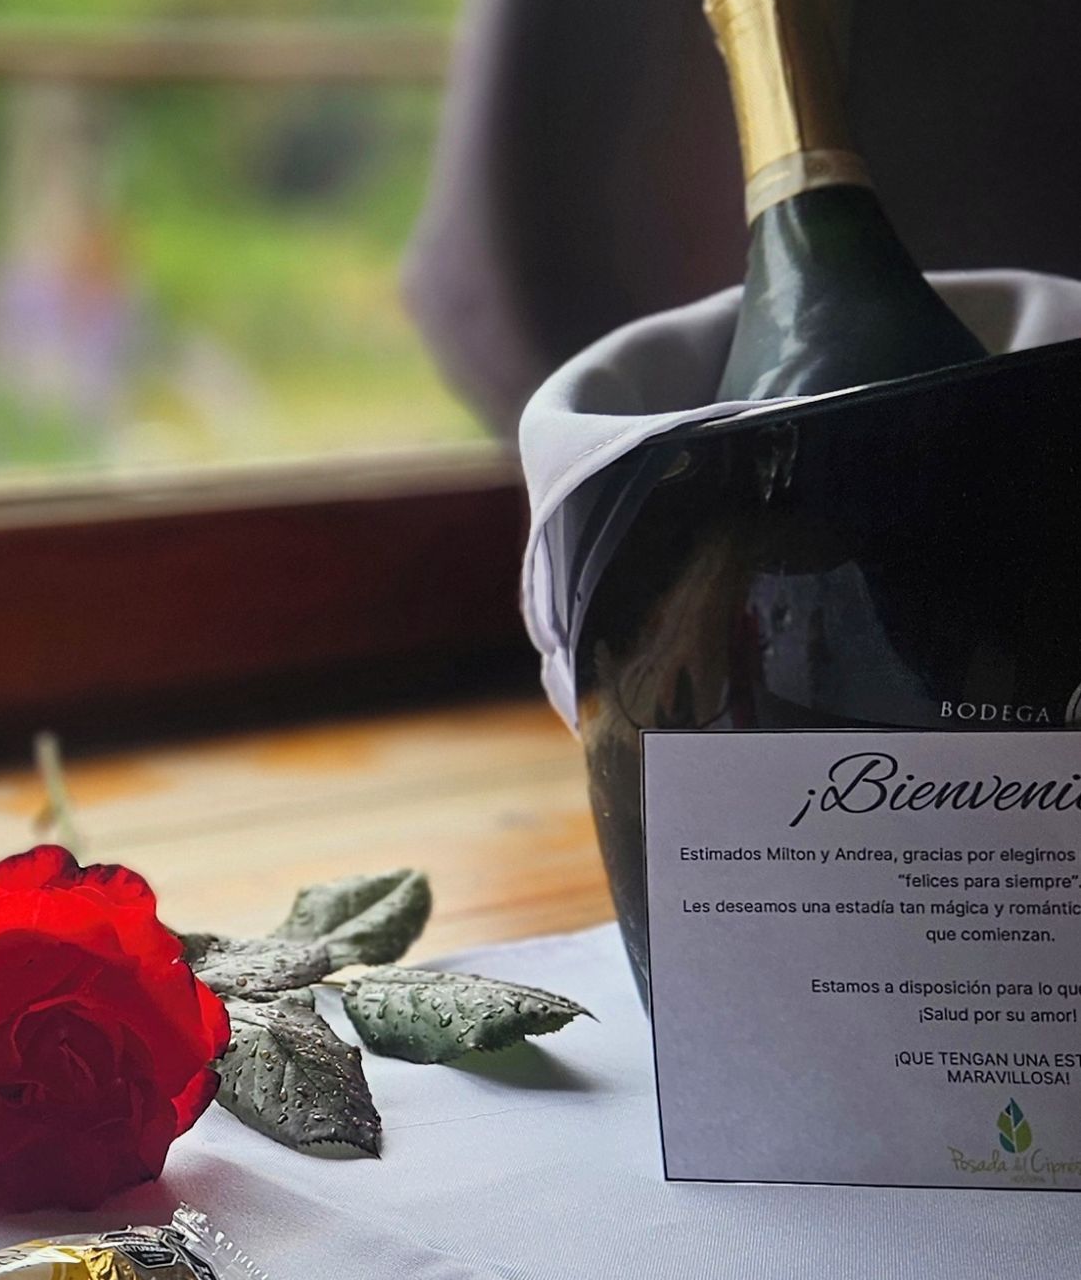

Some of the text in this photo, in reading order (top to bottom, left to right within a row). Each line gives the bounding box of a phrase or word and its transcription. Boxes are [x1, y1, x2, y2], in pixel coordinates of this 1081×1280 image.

[940, 700, 1049, 722] BODEGA
[789, 751, 1081, 827] ¡Bienveni
[681, 847, 1075, 865] Estimados Milton y Andrea, gracias por elegirnos
[898, 874, 959, 887] “felices
[964, 877, 1000, 890] para
[683, 900, 710, 912] Les
[716, 900, 797, 913] deseamos
[802, 903, 830, 913] una
[836, 900, 894, 914] estadía
[900, 902, 925, 914] tan
[931, 900, 988, 917] mágica
[994, 904, 1004, 918] y
[926, 928, 1055, 944] que comienzan.
[812, 979, 880, 993] Estamos
[885, 983, 893, 993] a
[899, 980, 991, 997] disposición
[996, 984, 1033, 998] para
[1039, 982, 1052, 995] lo
[919, 1007, 1077, 1024] ¡Salud por su amor!
[895, 1051, 934, 1067] ¡QUE
[938, 1052, 1008, 1066] TENGAN
[1014, 1054, 1050, 1067] UNA
[948, 1070, 1070, 1085] MARAVILLOSA!
